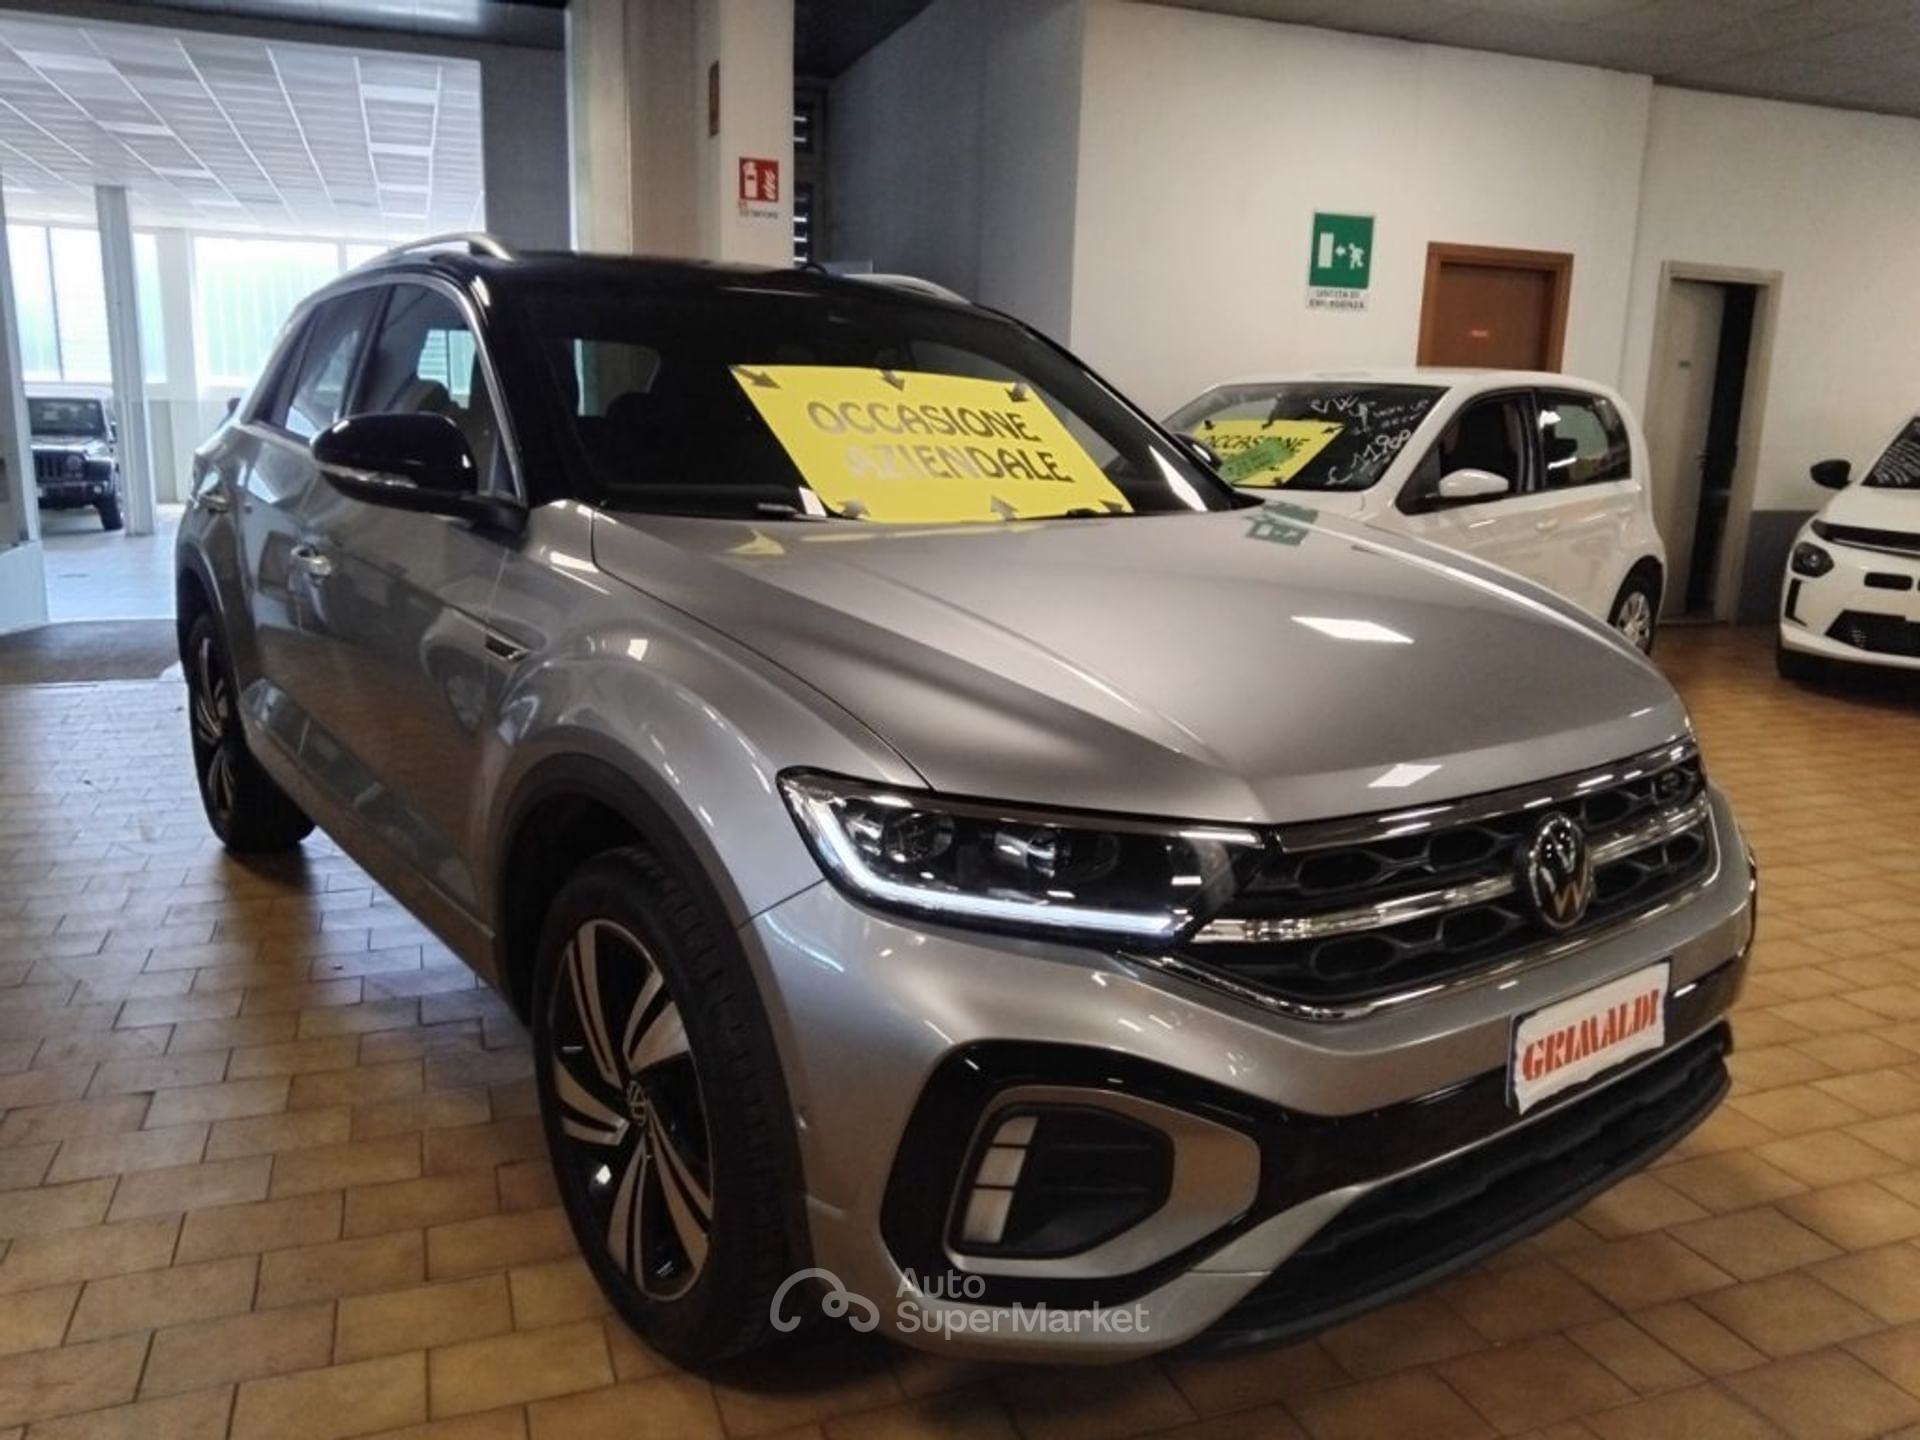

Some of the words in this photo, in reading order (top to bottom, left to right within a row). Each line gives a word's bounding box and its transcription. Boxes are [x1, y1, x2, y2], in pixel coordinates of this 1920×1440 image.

[807, 401, 1042, 442] OCCASIONE
[844, 445, 1075, 483] AZIENDALE
[1522, 989, 1659, 1081] GRIMALDI
